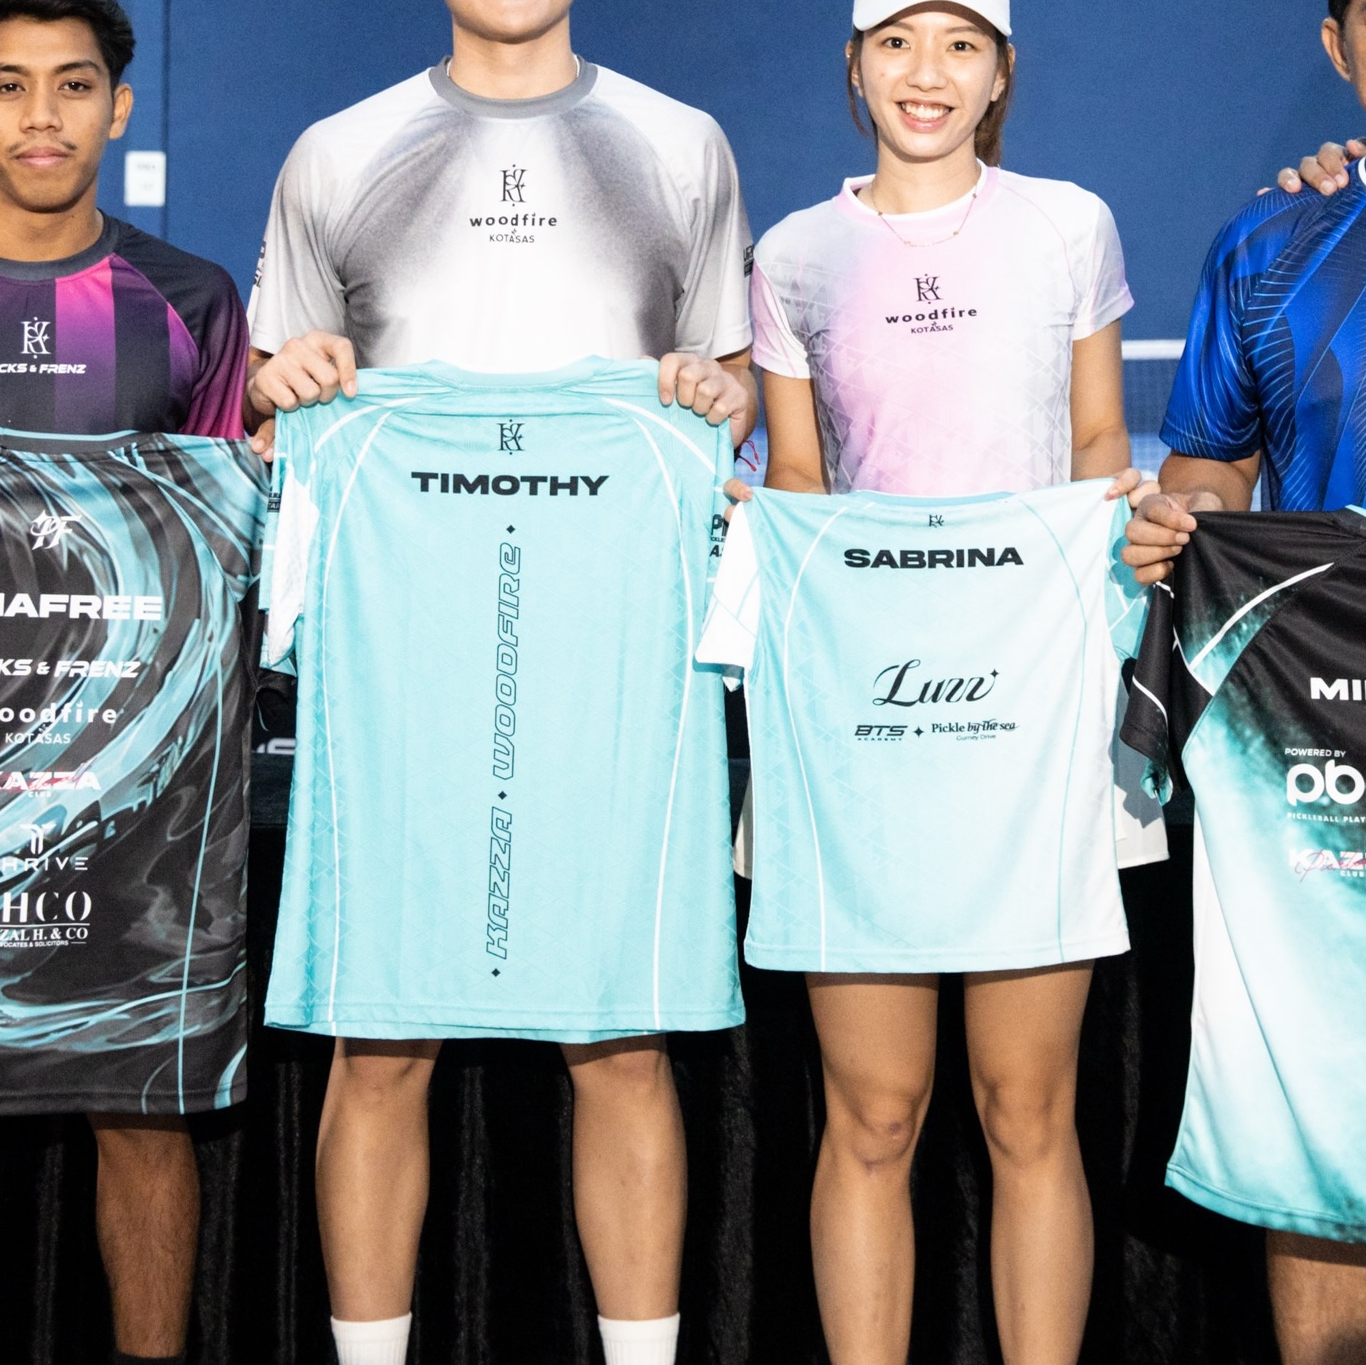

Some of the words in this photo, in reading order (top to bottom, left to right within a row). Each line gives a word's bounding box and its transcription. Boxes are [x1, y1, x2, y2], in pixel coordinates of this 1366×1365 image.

[469, 212, 557, 227] woodfire
[489, 233, 535, 243] KOTASAS
[885, 306, 977, 324] woodfire
[911, 324, 954, 334] KOTASAS
[29, 364, 37, 373] &
[39, 363, 87, 374] FRENZ
[411, 471, 610, 496] TIMOTHY
[844, 547, 1024, 569] SABRINA
[493, 542, 521, 781] WOODFIRE
[36, 661, 50, 675] &
[54, 660, 141, 678] FRENZ
[854, 725, 908, 736] BTS
[931, 722, 965, 733] Pickle
[967, 722, 981, 734] by
[999, 722, 1017, 732] sea
[4, 732, 71, 744] KOTASAS
[1284, 747, 1332, 757] POWERED
[1334, 749, 1346, 758] BY
[1287, 812, 1339, 823] PICKLEBALL
[486, 806, 513, 960] KAZZA
[32, 928, 47, 941] H.
[50, 927, 62, 940] &
[66, 927, 88, 940] CO
